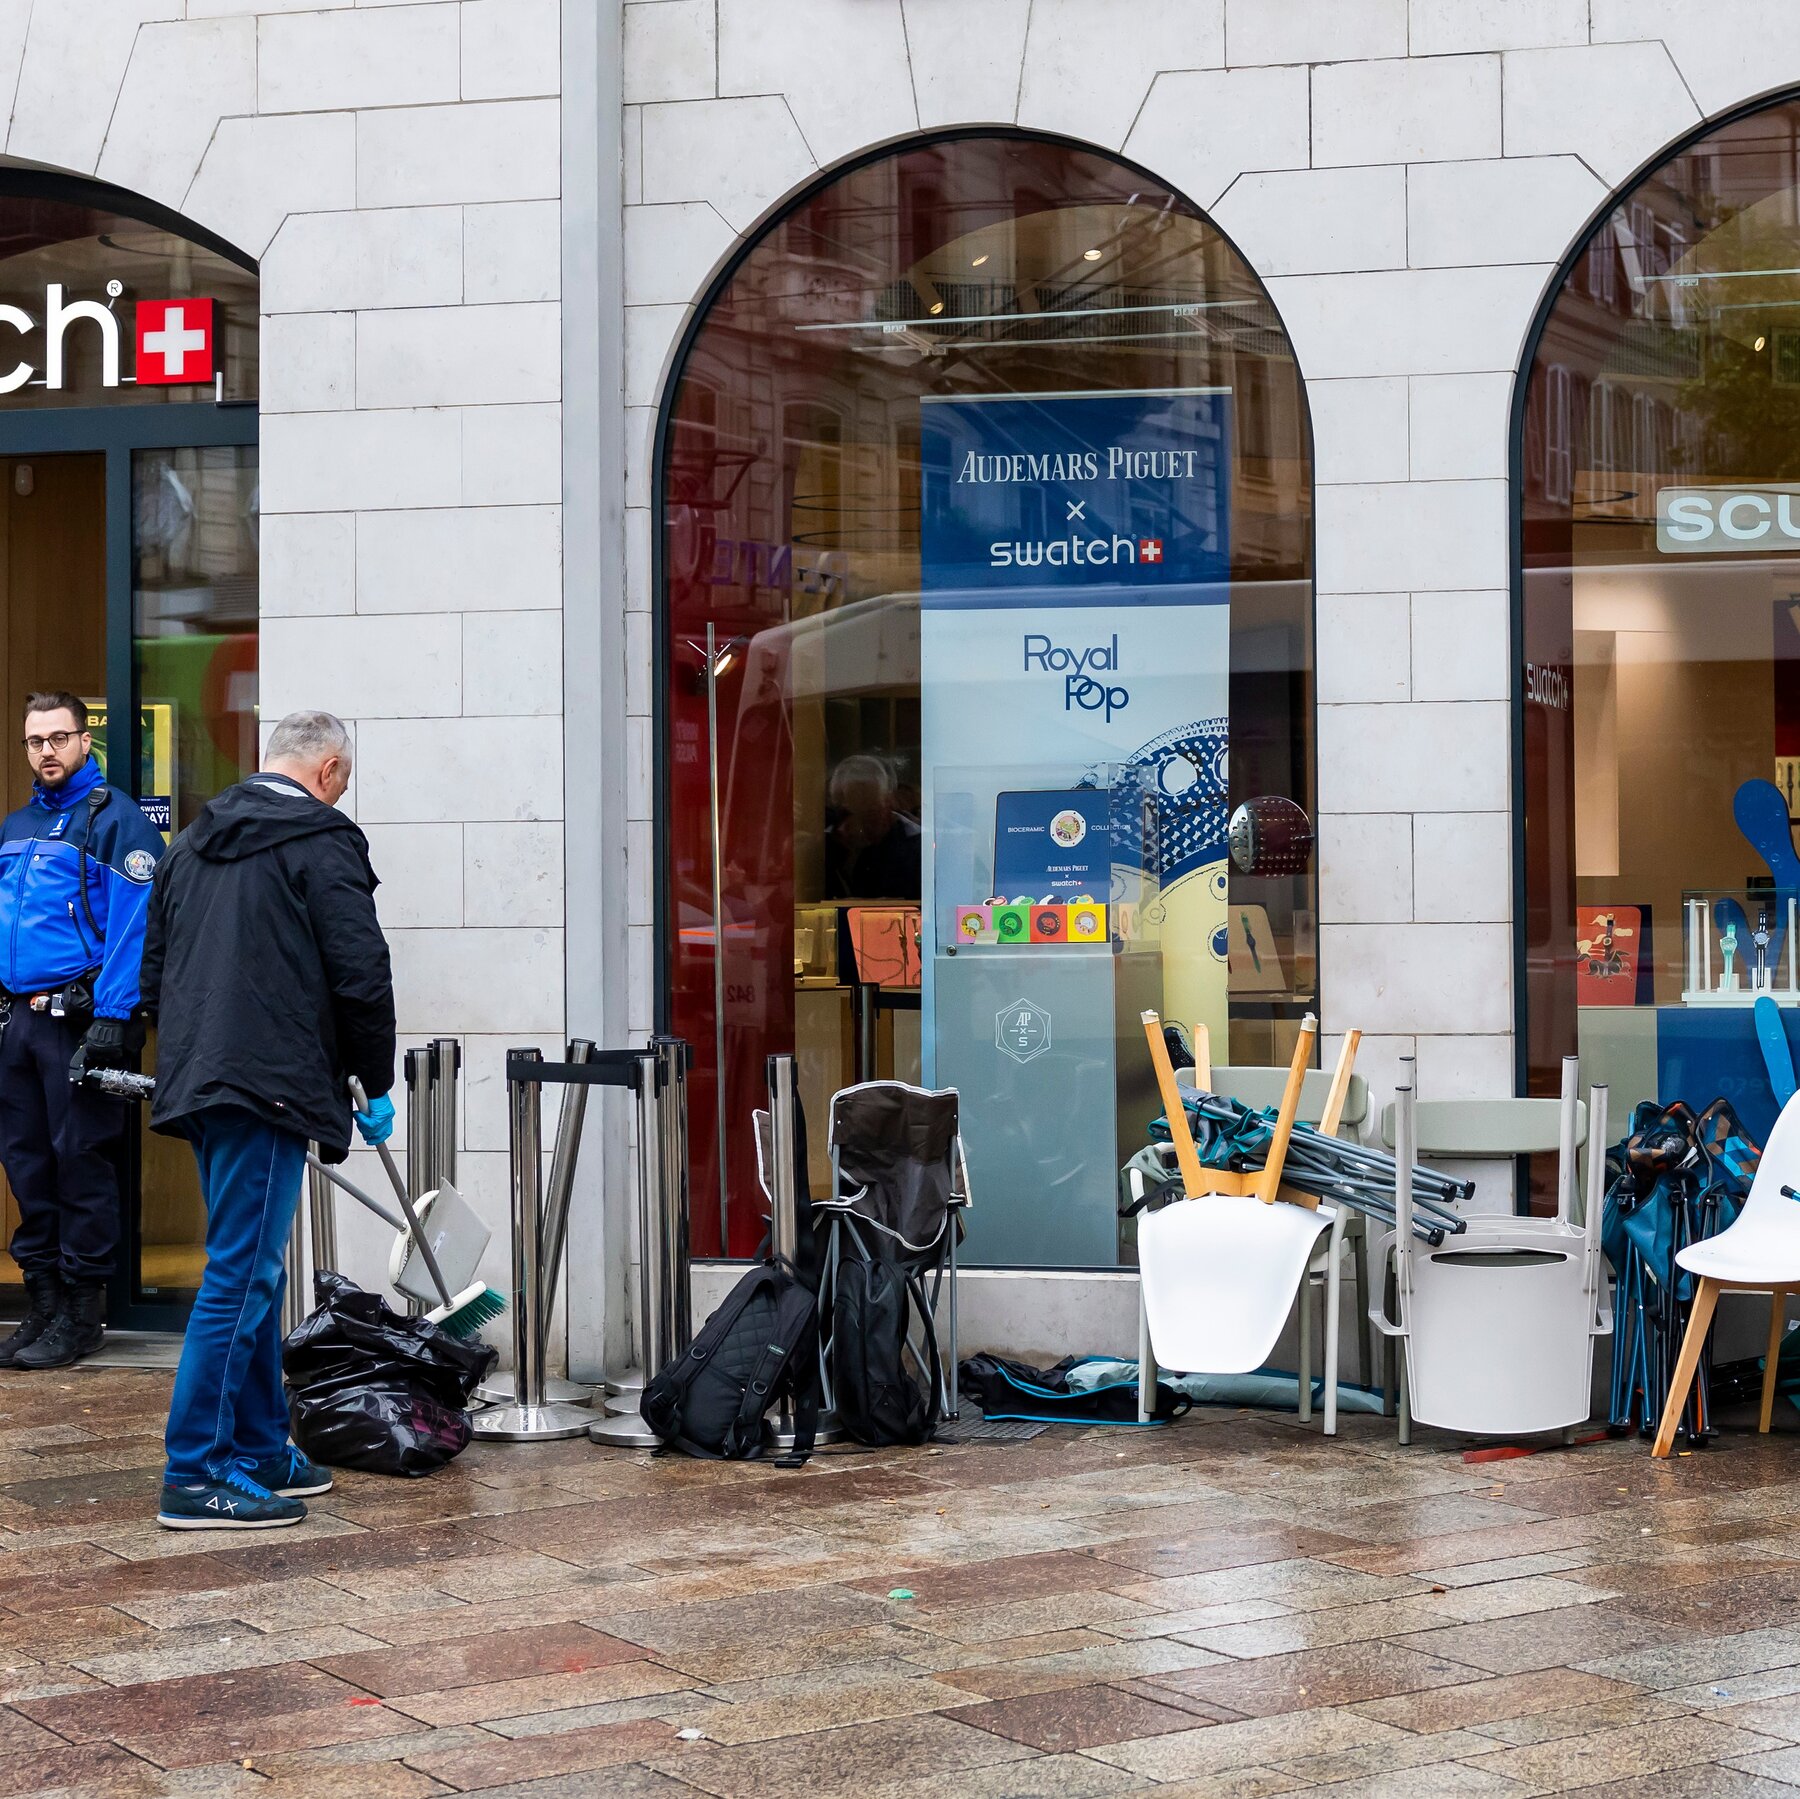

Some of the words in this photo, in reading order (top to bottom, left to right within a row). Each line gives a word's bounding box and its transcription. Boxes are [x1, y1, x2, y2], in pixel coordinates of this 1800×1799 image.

[957, 450, 1098, 483] AUDEMARS
[1107, 446, 1198, 480] PIGUET
[990, 534, 1135, 567] swatch
[1024, 633, 1118, 680] Royal
[1526, 661, 1563, 709] swatch
[144, 813, 169, 824] AY!
